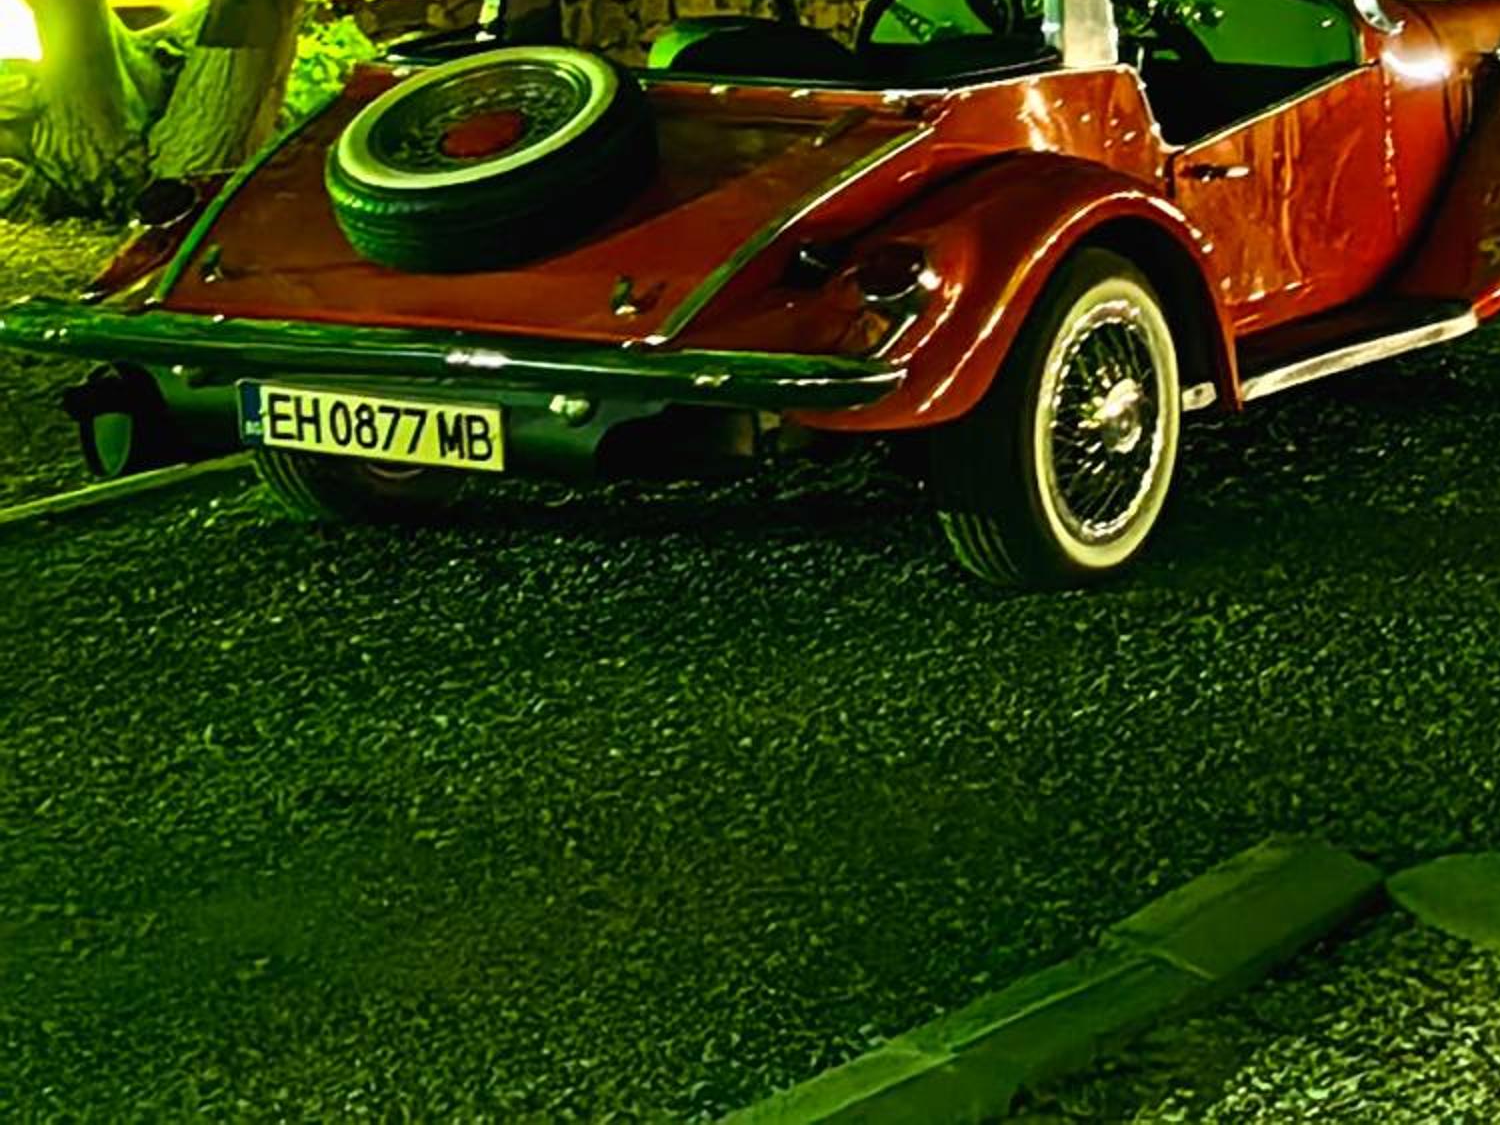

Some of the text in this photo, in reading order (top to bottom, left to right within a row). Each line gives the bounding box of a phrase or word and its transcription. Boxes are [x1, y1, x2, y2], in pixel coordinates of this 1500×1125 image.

[268, 392, 493, 461] EH 0877 MB
